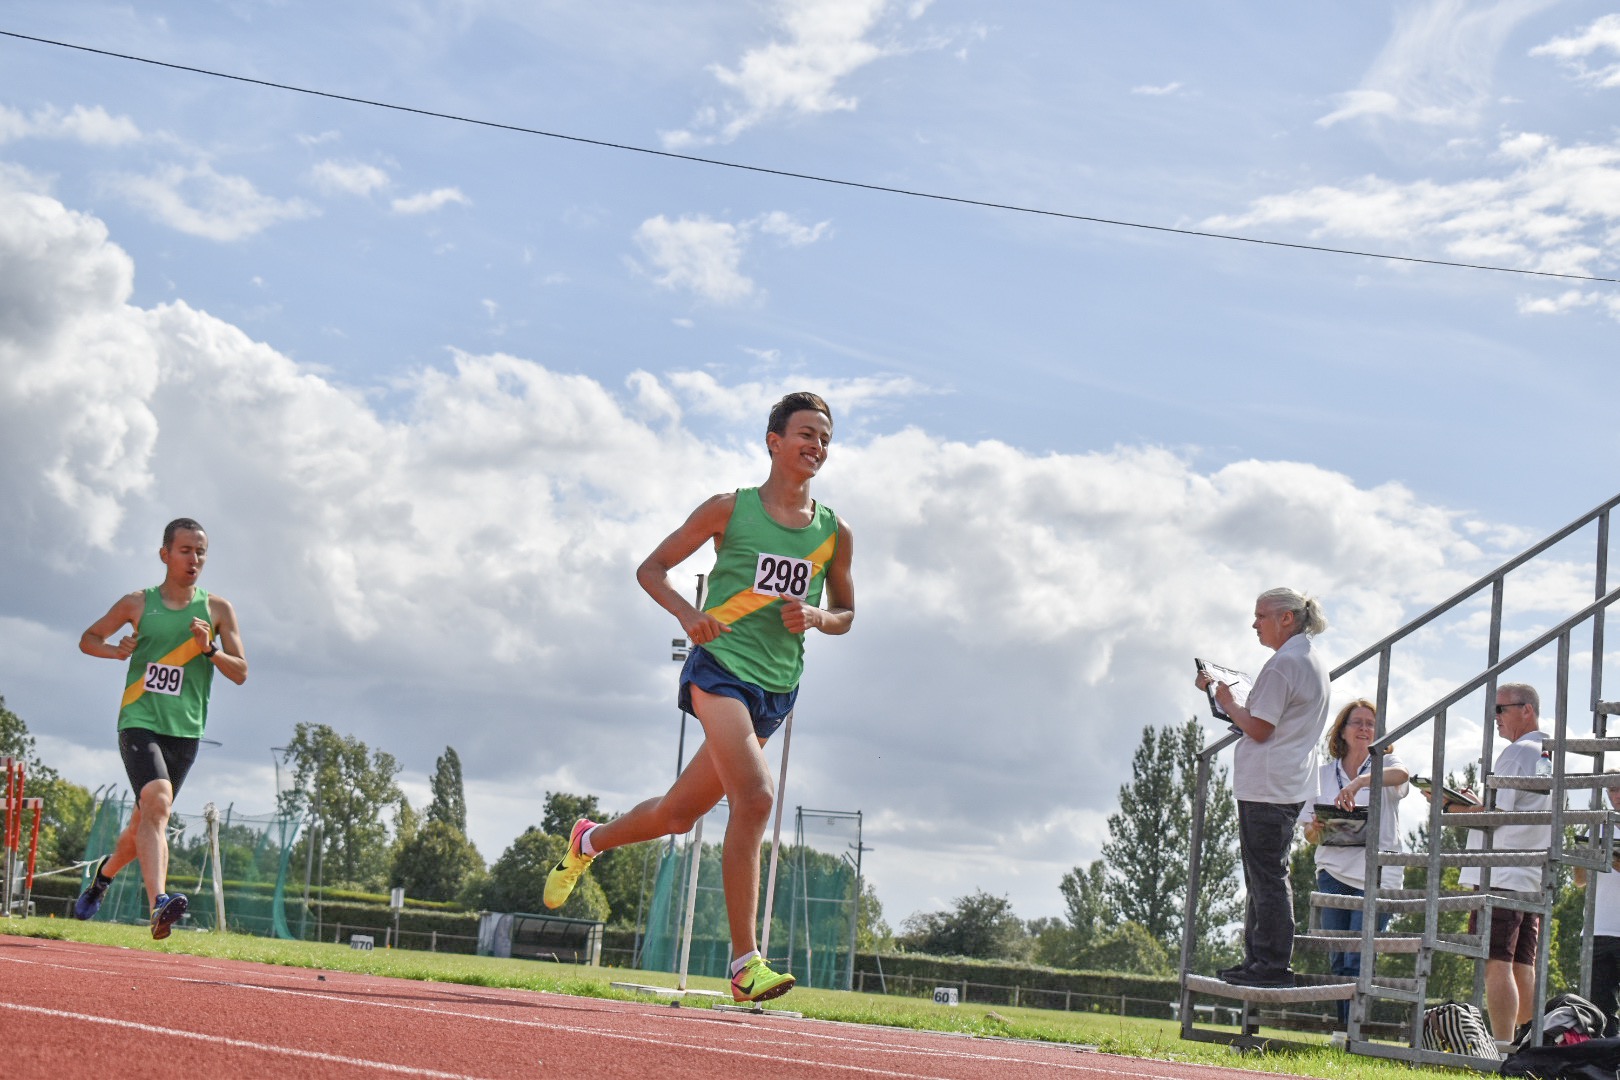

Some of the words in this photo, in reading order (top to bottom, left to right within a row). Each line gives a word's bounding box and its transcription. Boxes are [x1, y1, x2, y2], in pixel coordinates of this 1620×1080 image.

[758, 557, 808, 595] 298
[146, 665, 180, 692] 299
[359, 941, 373, 950] 70
[934, 992, 949, 1003] 60
